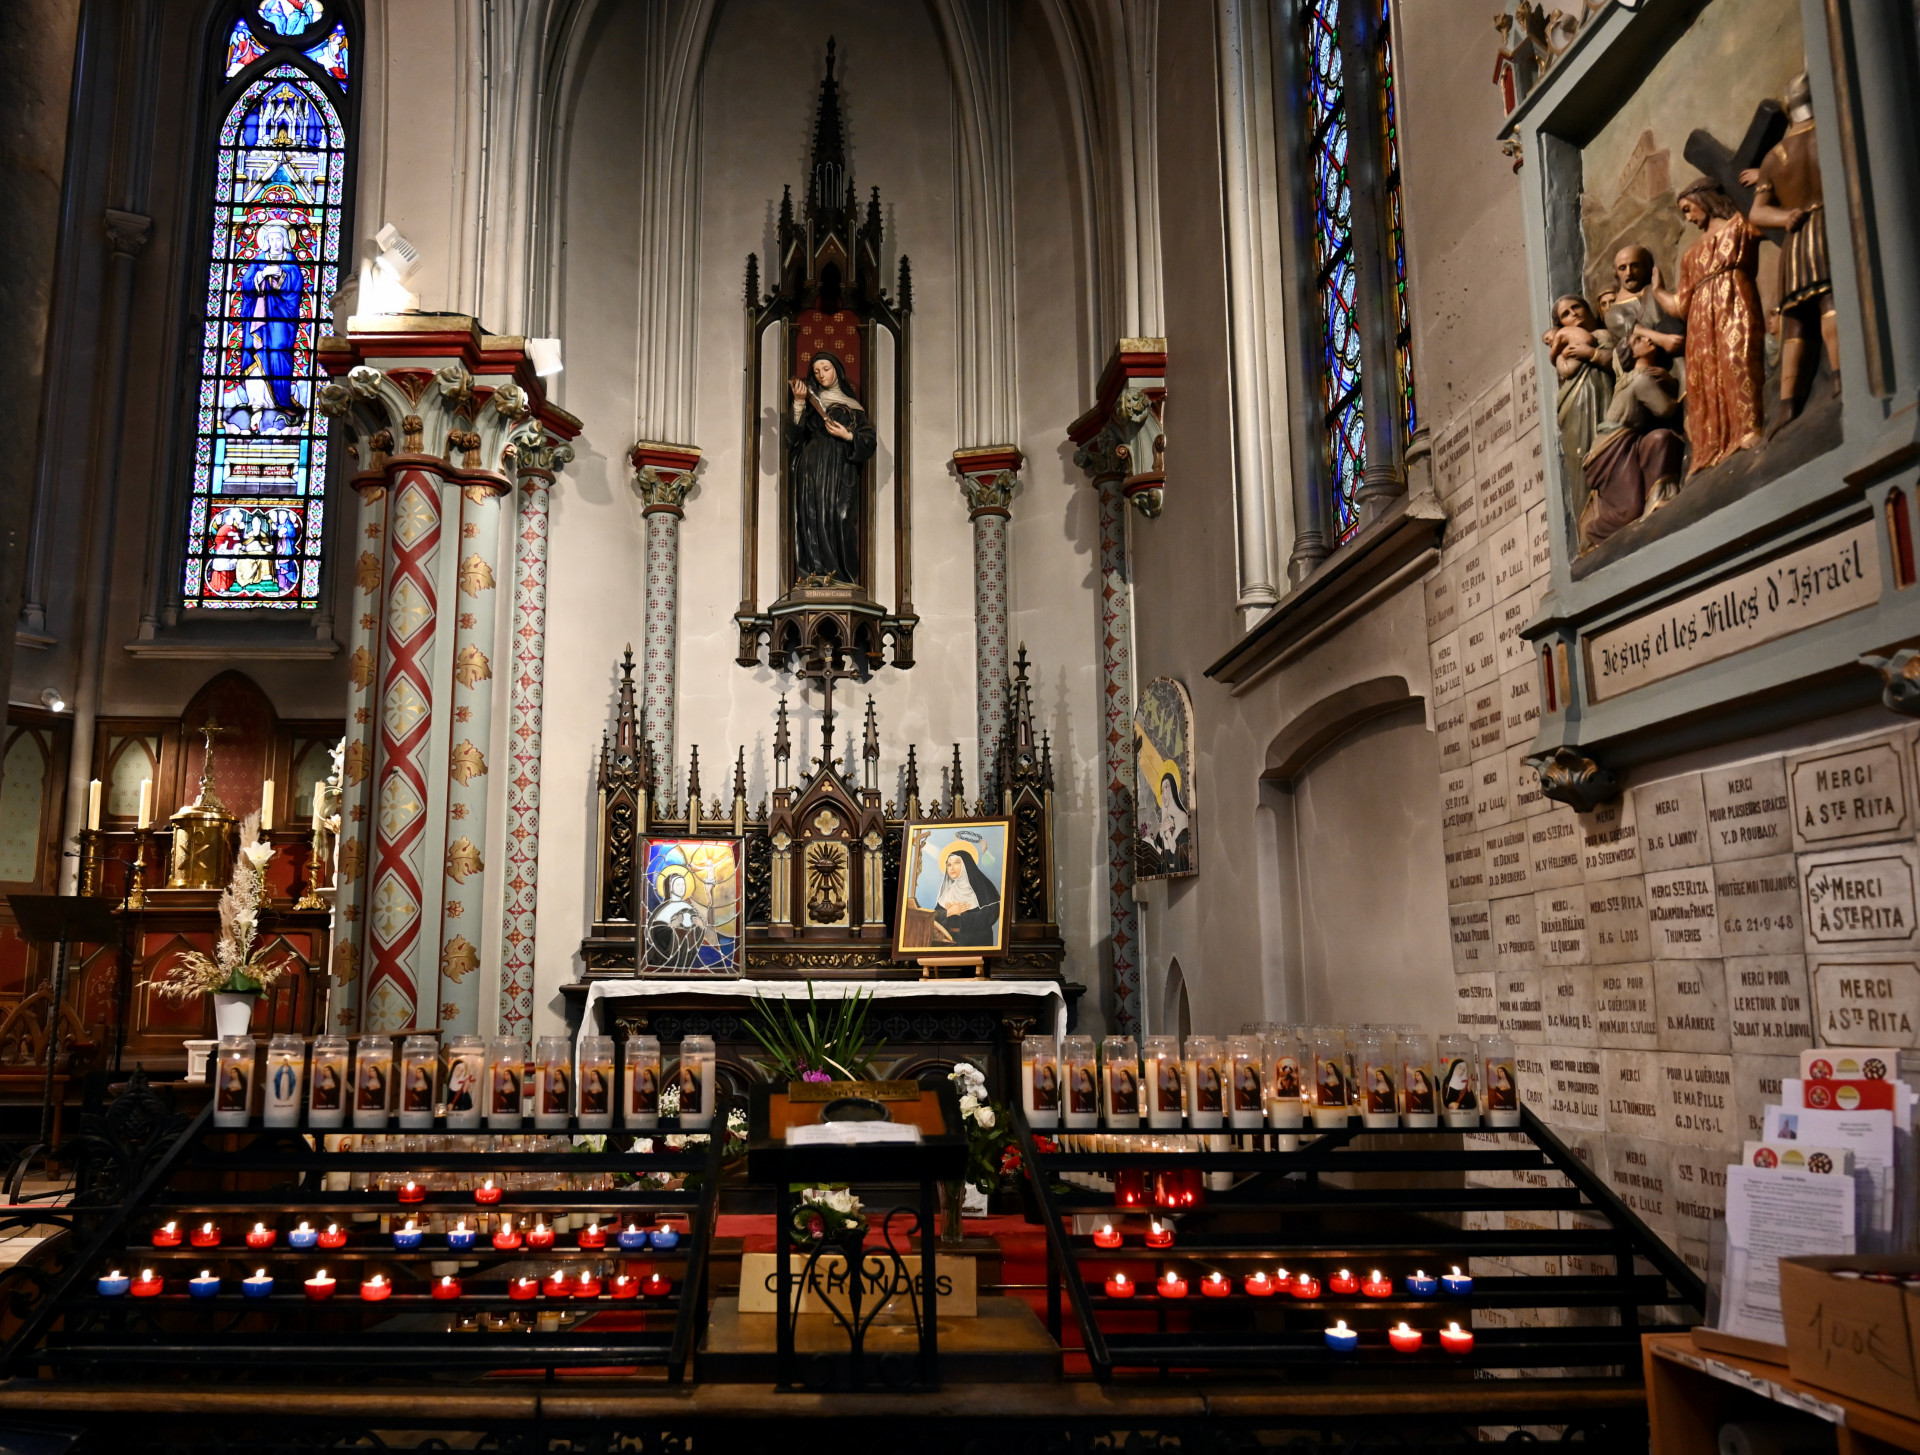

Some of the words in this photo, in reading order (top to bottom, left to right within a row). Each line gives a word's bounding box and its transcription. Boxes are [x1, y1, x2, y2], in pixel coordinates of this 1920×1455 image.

[1504, 496, 1517, 512] LILLE
[1466, 557, 1480, 574] MERCI
[1509, 560, 1523, 578] LILLE
[1470, 572, 1486, 590] RITA
[1506, 604, 1520, 621] MERCI
[1469, 632, 1484, 647] MERCI
[1602, 634, 1650, 676] Jésus
[1655, 624, 1668, 656] et
[1673, 614, 1698, 650] les
[1701, 587, 1758, 638] Filles
[1438, 646, 1452, 661] MERCI
[1442, 661, 1456, 677] RITA
[1511, 682, 1530, 698] JEAN
[1477, 696, 1492, 712] MERCI
[1508, 714, 1522, 728] LILLE
[1524, 706, 1540, 722] 1948
[1448, 780, 1464, 792] MERCI
[1483, 772, 1497, 786] MERCI
[1728, 777, 1752, 795] MERCI
[1816, 764, 1872, 792] MERCI
[1454, 794, 1469, 808] RITA
[1490, 796, 1504, 810] LILLE
[1656, 799, 1679, 816] MERCI
[1710, 808, 1726, 822] POUR
[1728, 800, 1761, 820] PLUSIEURS
[1762, 796, 1788, 813] GRACES
[1854, 796, 1895, 820] RITA
[1596, 809, 1614, 824] MERCI
[1532, 831, 1546, 844] MERCI
[1558, 824, 1574, 838] RITA
[1599, 834, 1606, 844] MA
[1610, 826, 1636, 842] GUÉRISON
[1668, 830, 1698, 847] LANNOY
[1740, 824, 1778, 842] ROUBAIX
[1652, 885, 1671, 898] MERCI
[1686, 880, 1708, 896] RITA
[1746, 880, 1760, 894] MOI
[1760, 876, 1798, 892] TOUJOURS
[1832, 878, 1882, 900] MERCI
[1552, 900, 1568, 912] MERCI
[1590, 902, 1606, 914] MERCI
[1621, 896, 1644, 909] RITA
[1657, 906, 1684, 920] CHAMPION
[1690, 904, 1714, 918] FRANCE
[1506, 914, 1520, 926] MERCI
[1862, 906, 1904, 928] RITA
[1620, 930, 1638, 942] LOOS
[1665, 928, 1702, 944] THUMERIES
[1603, 978, 1621, 990] MERCI
[1626, 978, 1644, 989] POUR
[1741, 971, 1764, 986] MERCI
[1768, 971, 1790, 986] POUR
[1510, 982, 1524, 992] MERCI
[1558, 985, 1574, 996] MERCI
[1678, 982, 1700, 995] MERCI
[1840, 978, 1892, 999] MERCI
[1500, 1002, 1511, 1012] POUR
[1512, 1002, 1518, 1011] MA
[1598, 1000, 1605, 1011] LA
[1608, 996, 1636, 1012] GUÉRISON
[1639, 1000, 1646, 1012] DE
[1734, 998, 1745, 1011] LE
[1746, 997, 1776, 1011] RETOUR
[1611, 1020, 1628, 1034] MARI
[1640, 1020, 1656, 1034] LILLE
[1734, 1021, 1759, 1036] SOLDAT
[1869, 1009, 1912, 1033] RITA
[1527, 1060, 1543, 1074] RITA
[1550, 1060, 1564, 1072] MERCI
[1565, 1060, 1576, 1072] POUR
[1620, 1069, 1640, 1082] MERCI
[1666, 1068, 1682, 1080] POUR
[1684, 1068, 1692, 1081] LA
[1696, 1066, 1730, 1084] GUÉRISON
[1558, 1080, 1566, 1092] DES
[1568, 1080, 1599, 1095] PRISONNIERS
[1760, 1079, 1782, 1094] MERC
[1526, 1089, 1543, 1103] CROIX
[1673, 1091, 1682, 1104] DE
[1684, 1092, 1696, 1106] MA
[1696, 1091, 1724, 1109] FILLE
[1582, 1102, 1598, 1116] LILLE
[1626, 1151, 1646, 1166] MERCI
[1614, 1170, 1628, 1185] POUR
[1629, 1173, 1642, 1187] UNE
[1642, 1176, 1664, 1192] GRACE
[1640, 1196, 1662, 1214] LILLE
[1676, 1200, 1711, 1220] PROTÉGEZ
